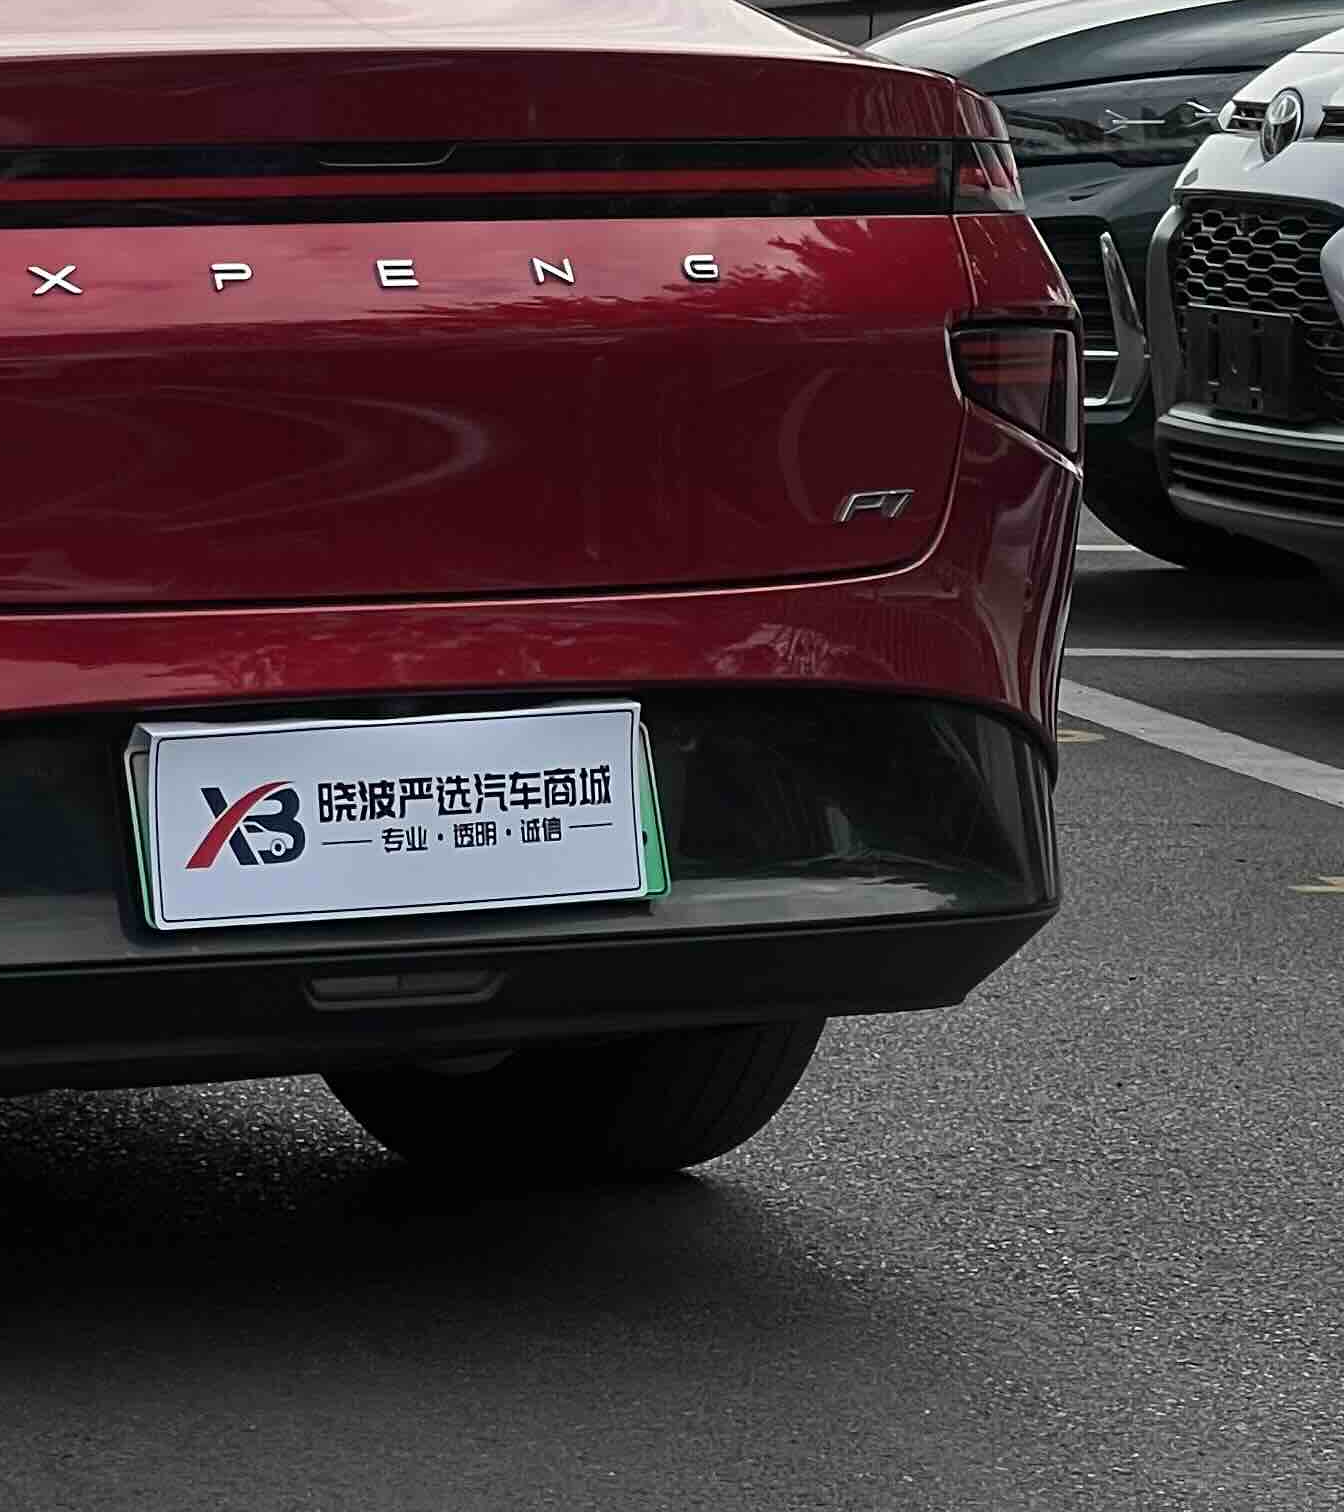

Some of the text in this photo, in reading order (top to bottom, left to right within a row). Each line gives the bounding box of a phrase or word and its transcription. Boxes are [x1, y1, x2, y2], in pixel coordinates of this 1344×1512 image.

[27, 253, 720, 295] XPENG
[317, 765, 612, 823] 晓波严选汽车商城
